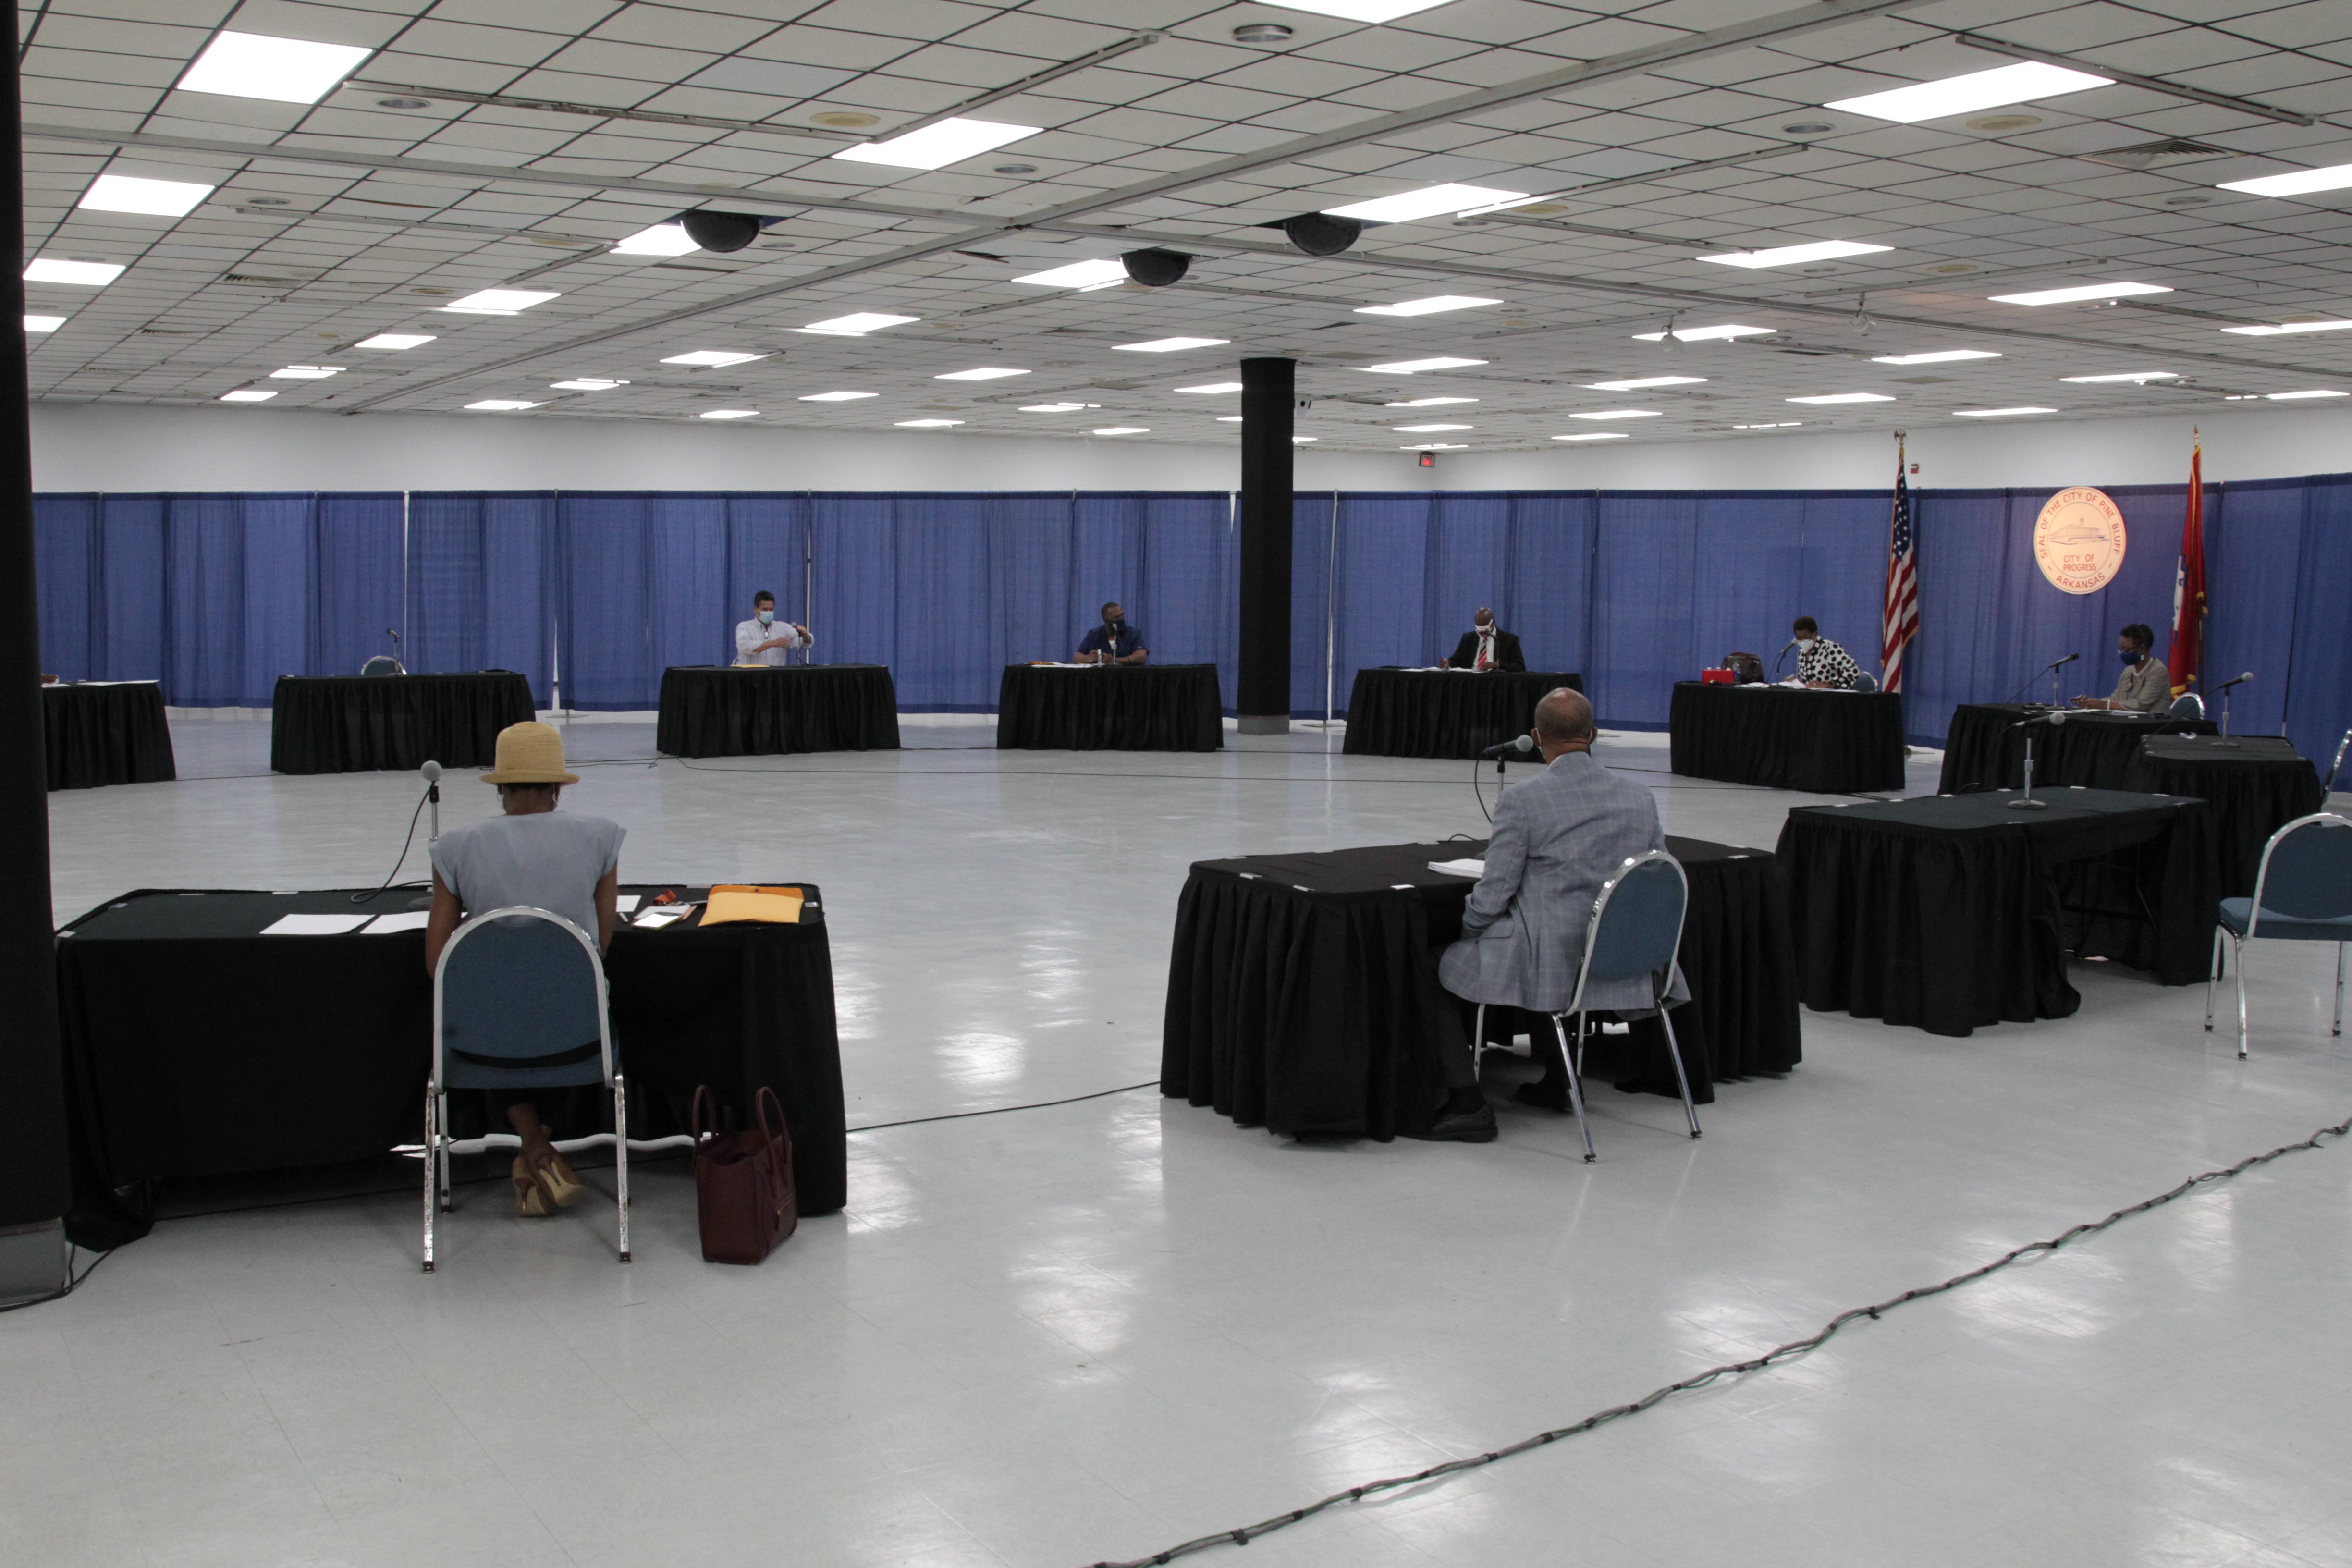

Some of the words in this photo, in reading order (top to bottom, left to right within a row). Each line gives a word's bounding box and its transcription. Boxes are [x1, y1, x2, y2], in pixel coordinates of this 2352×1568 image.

[2063, 491, 2082, 502] CITY
[2086, 493, 2098, 501] OF
[2047, 500, 2061, 515] THE
[2099, 500, 2115, 519] PINE
[2041, 517, 2048, 529] OF
[2038, 534, 2047, 559] SEAL
[2112, 523, 2121, 555] BLUFF
[2056, 572, 2106, 588] ARKANSAS
